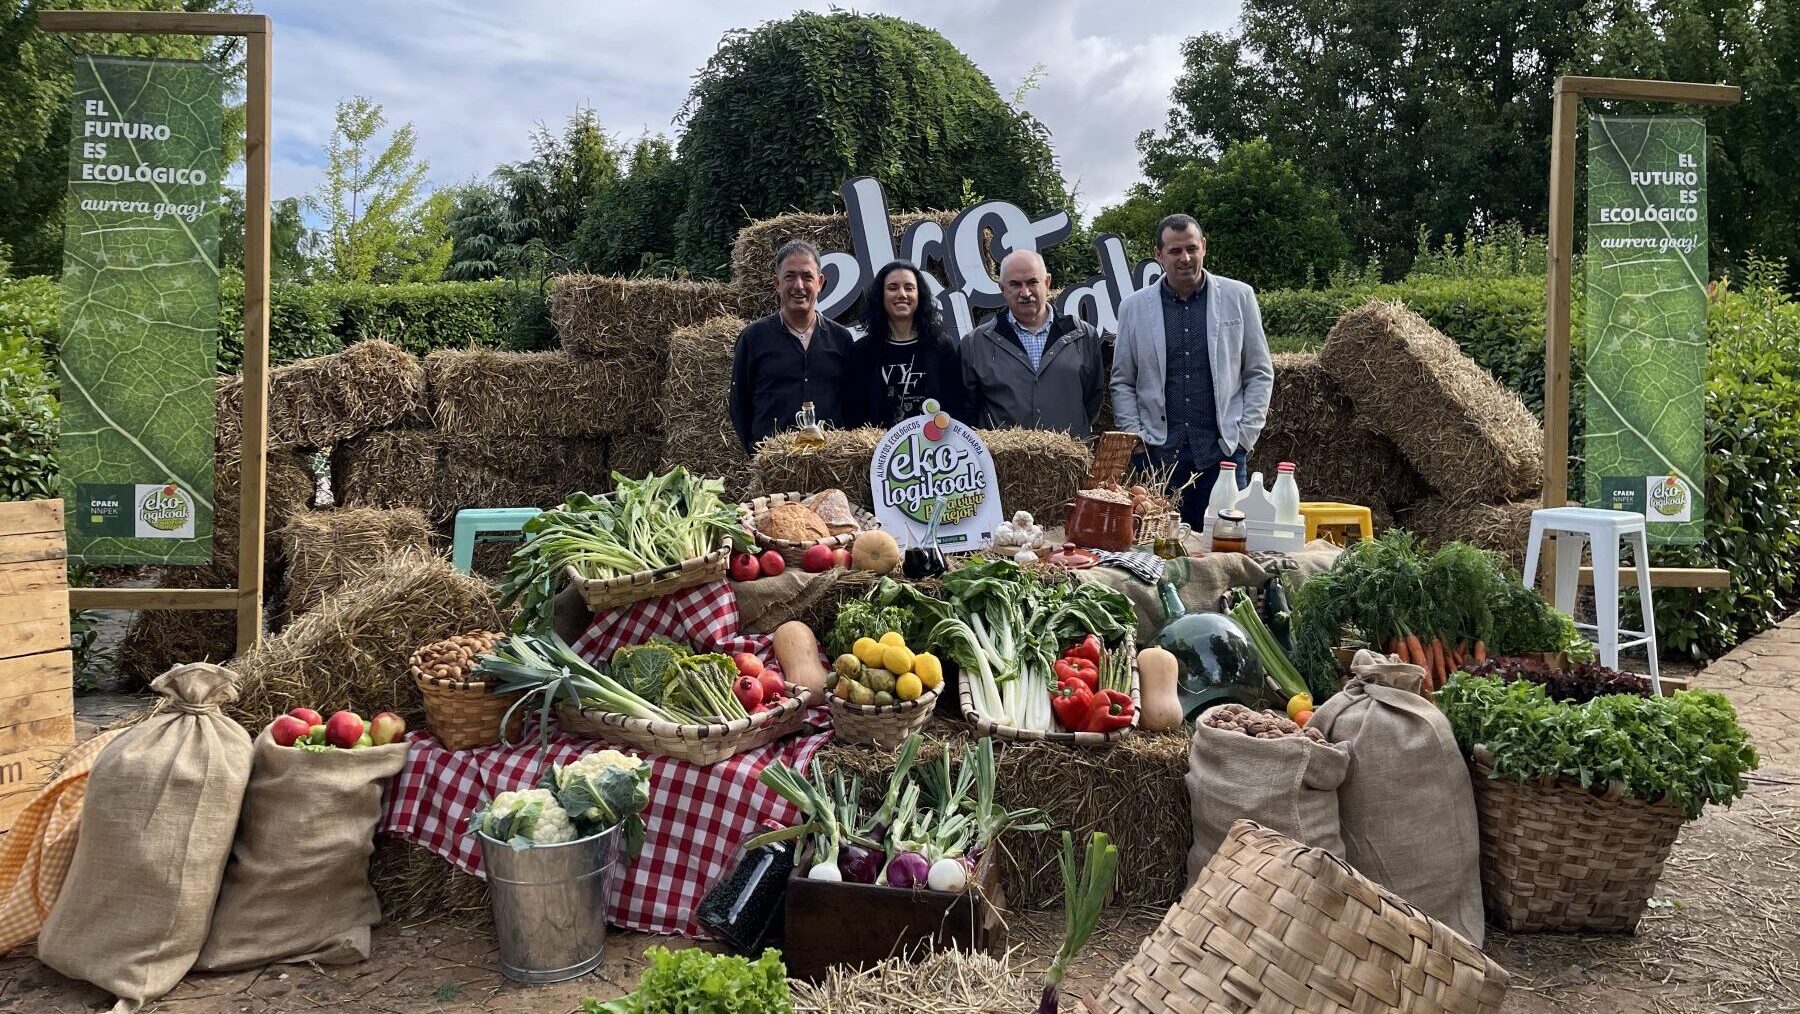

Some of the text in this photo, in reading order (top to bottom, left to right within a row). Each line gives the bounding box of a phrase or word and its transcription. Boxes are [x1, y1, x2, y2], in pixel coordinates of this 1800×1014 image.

[85, 100, 108, 116] EL
[84, 121, 171, 141] FUTURO
[83, 142, 107, 159] ES
[1678, 153, 1698, 168] EL
[82, 162, 207, 186] ECOLÓGICO
[1630, 171, 1698, 186] FUTURO
[1679, 189, 1698, 204] ES
[80, 200, 206, 223] aurrera goaz!
[1600, 204, 1698, 222] ECOLÓGICO
[1600, 234, 1698, 254] aurrera goaz!
[876, 420, 984, 478] ALIMENTOS ECOLÓGICOS DE NAVARRA
[887, 433, 969, 481] eko-
[881, 462, 986, 513] logikoak
[90, 500, 119, 508] CPAEN
